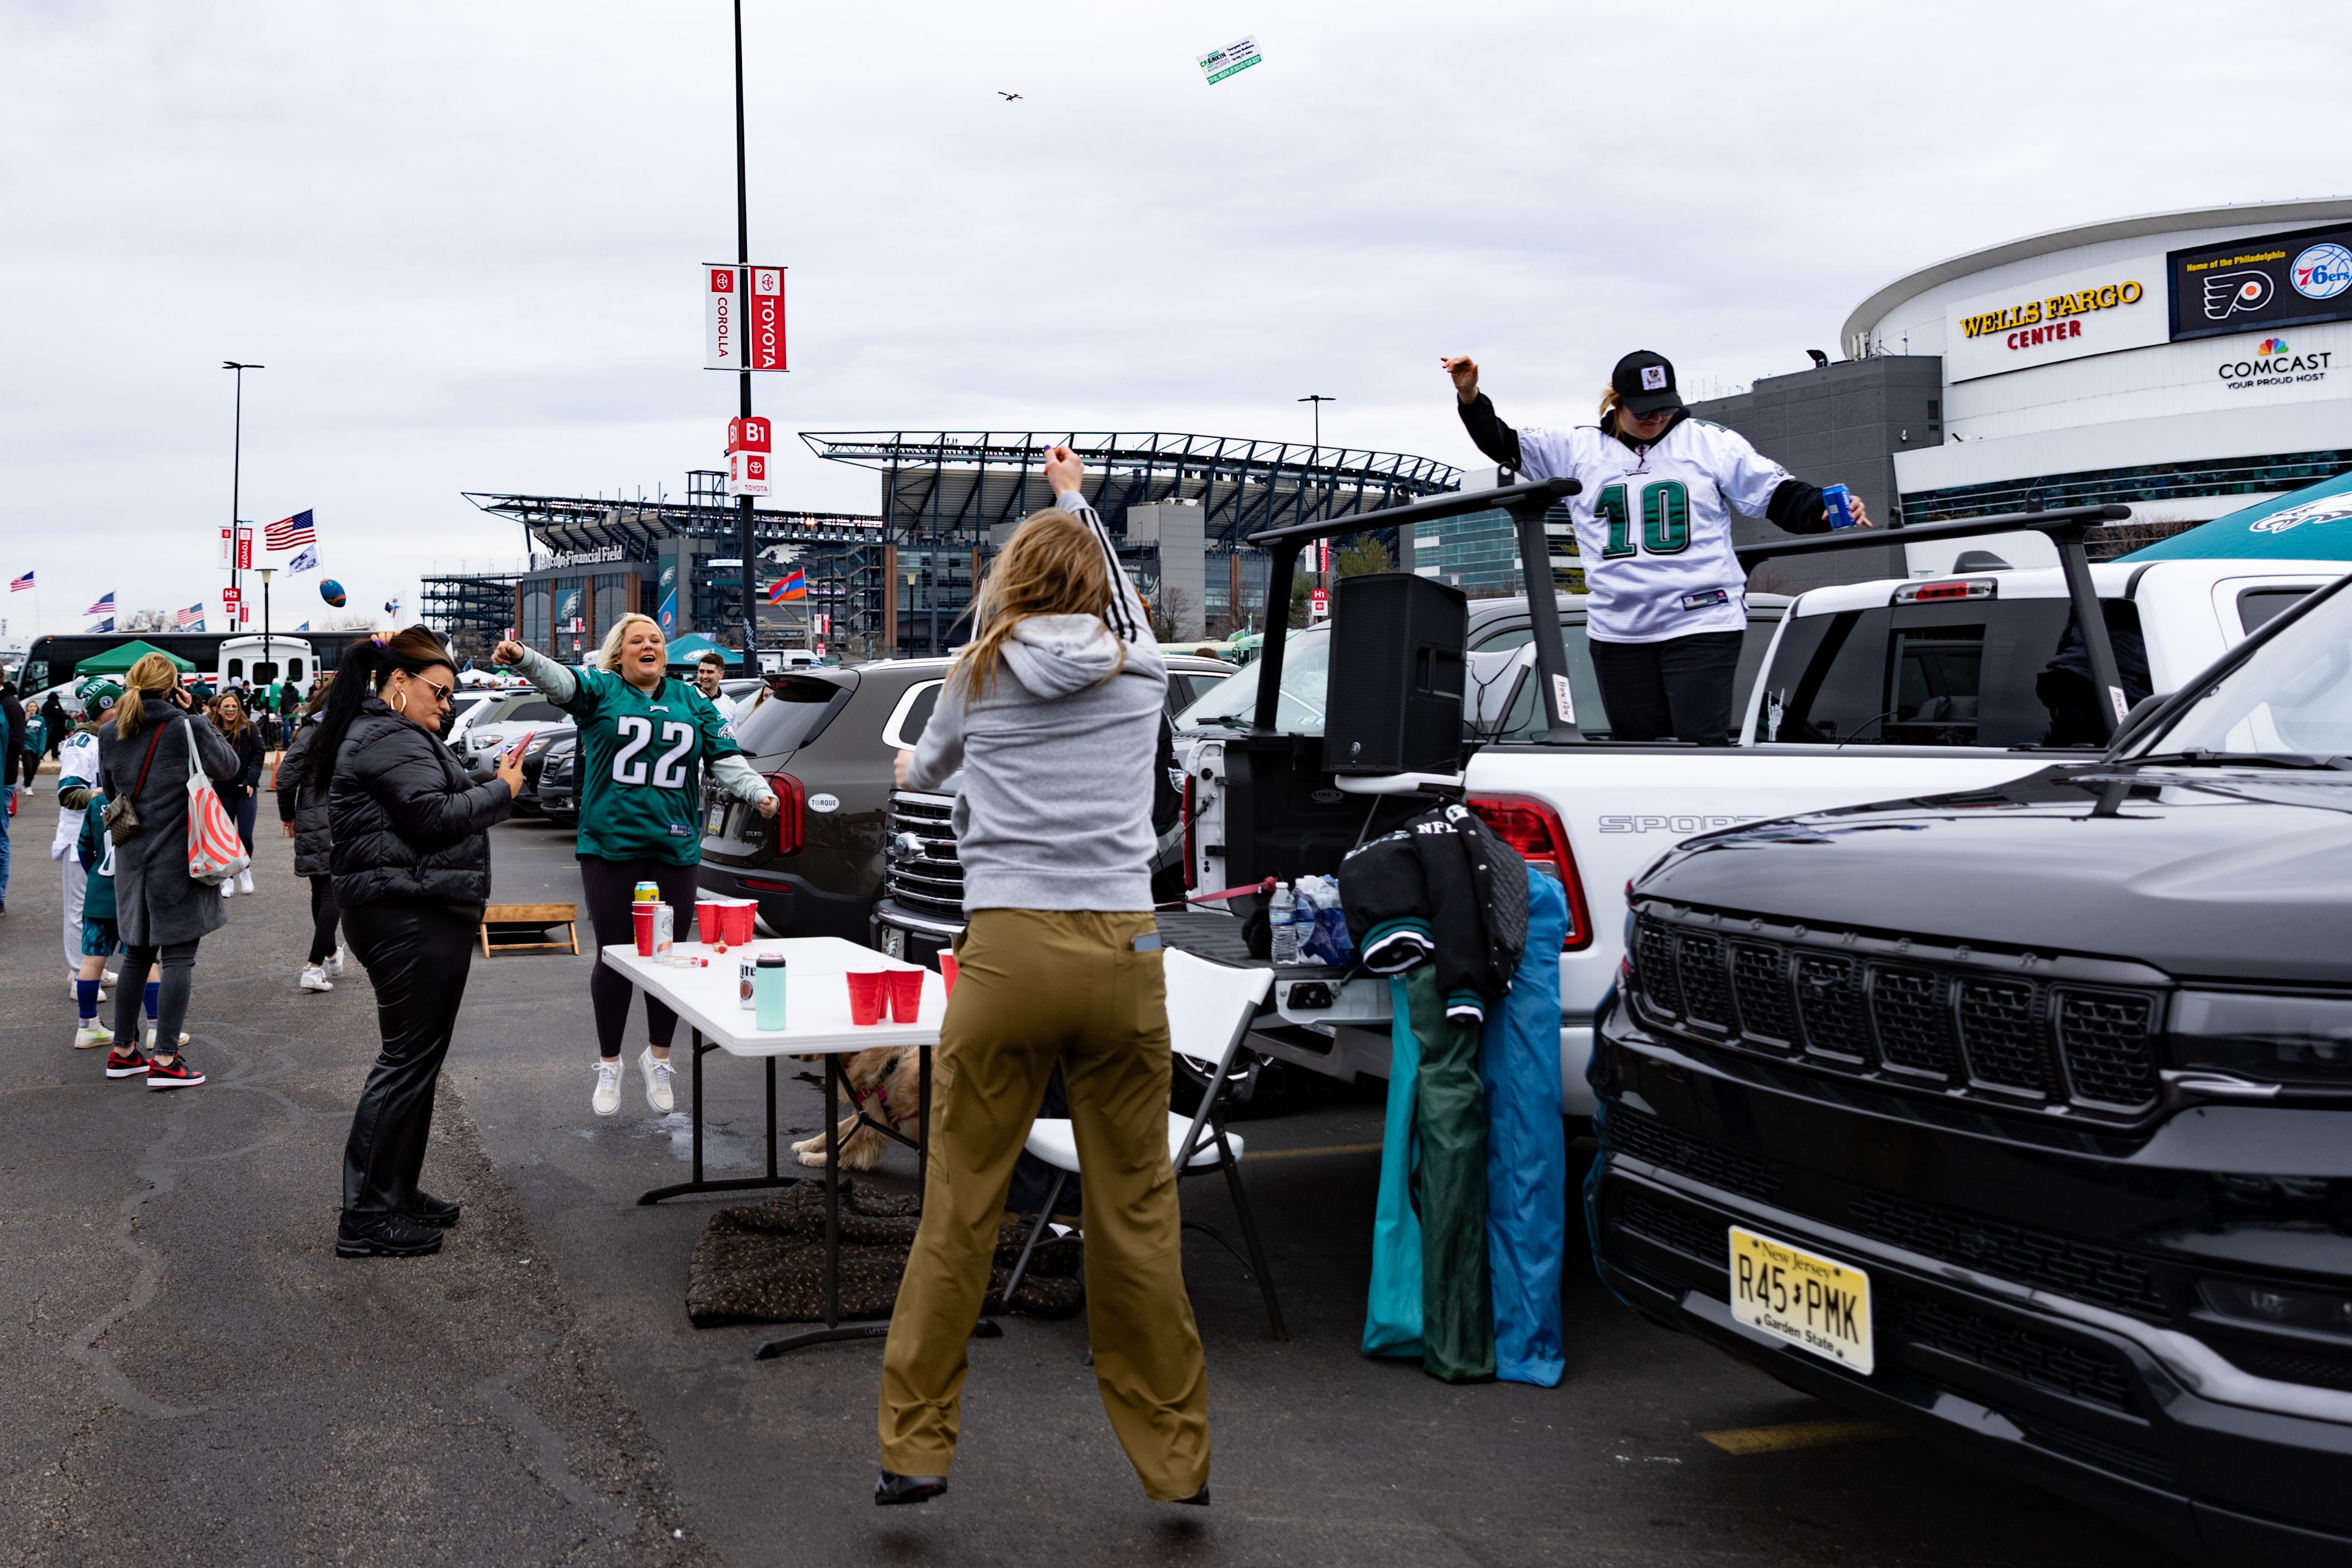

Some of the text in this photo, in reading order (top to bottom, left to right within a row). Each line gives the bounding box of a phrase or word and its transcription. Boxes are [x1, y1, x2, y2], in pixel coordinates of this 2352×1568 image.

[2187, 251, 2286, 272] Home of the Philadelphia
[2298, 265, 2350, 286] 76ers
[1960, 281, 2143, 338] WELLS FARGO
[718, 298, 728, 357] COROLLA
[761, 298, 776, 368] TOYOTA
[2008, 320, 2081, 350] CENTER
[2219, 352, 2332, 379] COMCAST
[2226, 372, 2325, 390] YOUR PROUD HOST
[730, 424, 737, 444] B1
[746, 422, 764, 442] B1
[1593, 479, 1691, 560] 10
[539, 544, 623, 570] Lincoln Financial Field
[224, 590, 238, 598] H2
[612, 716, 694, 788] 22
[1416, 821, 1459, 834] NFL
[1671, 905, 2038, 970] WAGONEER
[1761, 1241, 1832, 1281] New Jersey
[1764, 1313, 1834, 1352] Garden State
